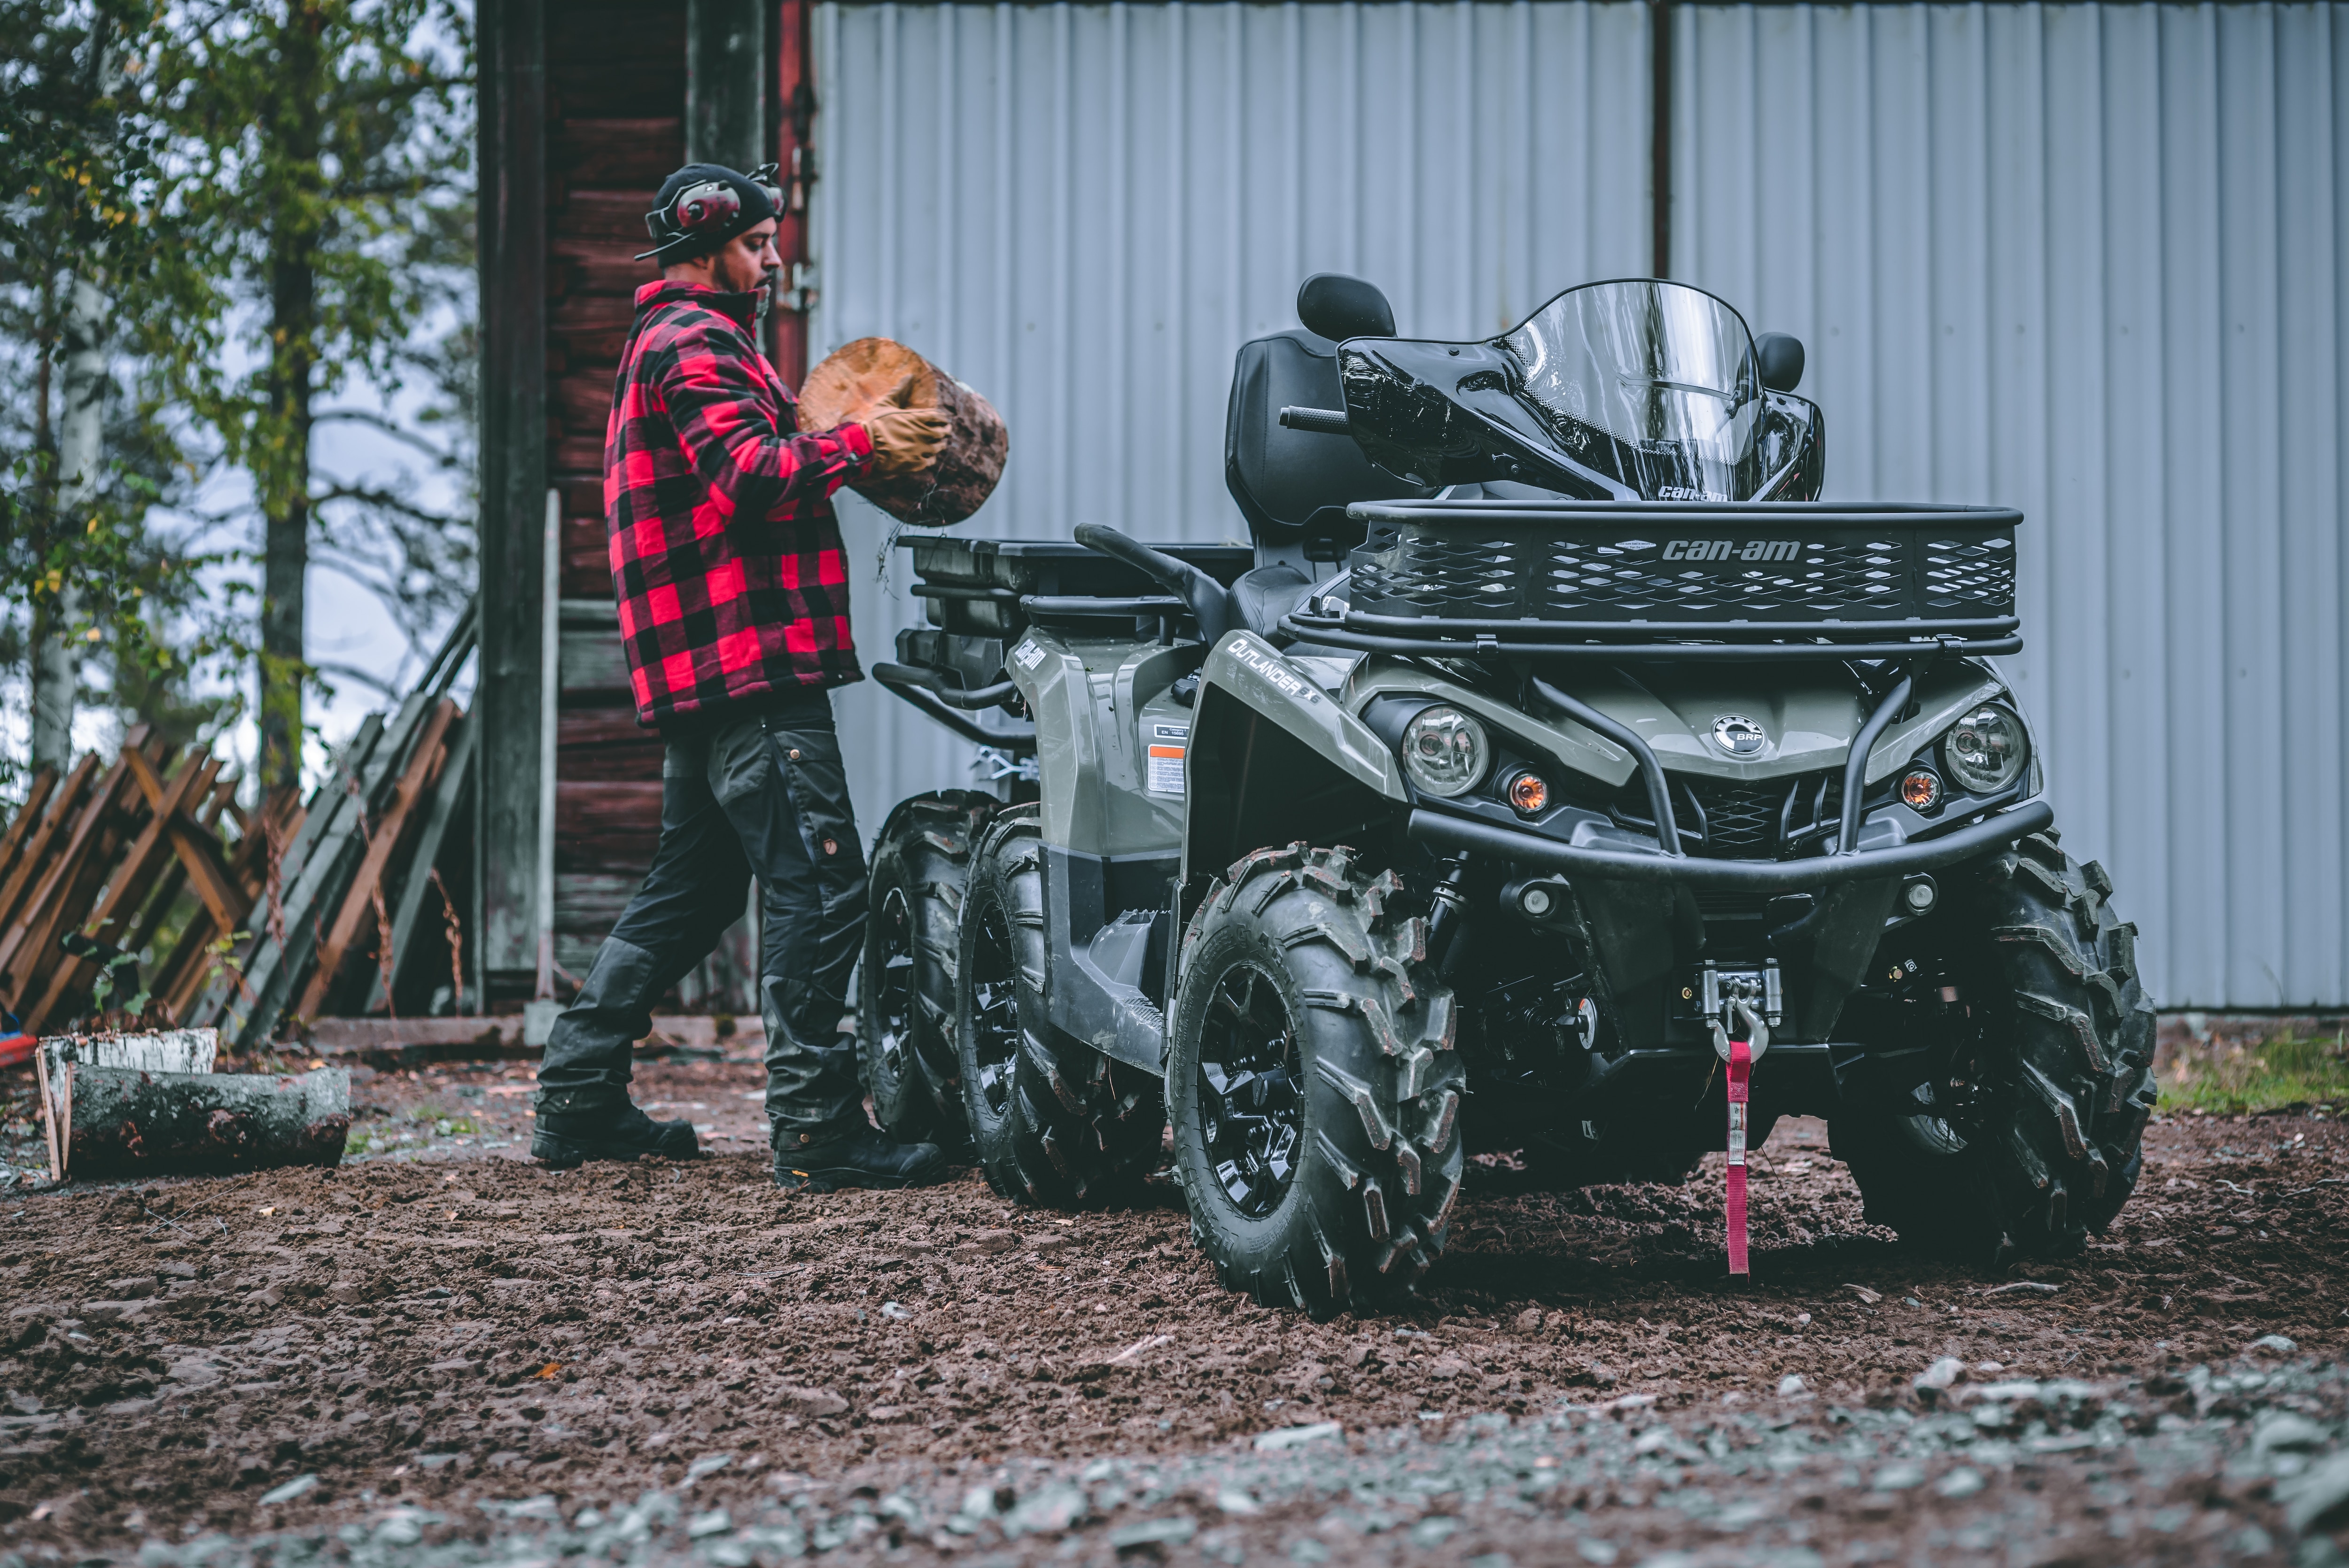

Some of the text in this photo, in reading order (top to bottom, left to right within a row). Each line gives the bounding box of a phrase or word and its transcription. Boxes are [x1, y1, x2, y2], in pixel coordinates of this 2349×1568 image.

[1658, 485, 1728, 502] can-am
[1662, 540, 1801, 561] can-am
[1014, 638, 1047, 671] can-am
[1227, 638, 1301, 696] OUTLANDER
